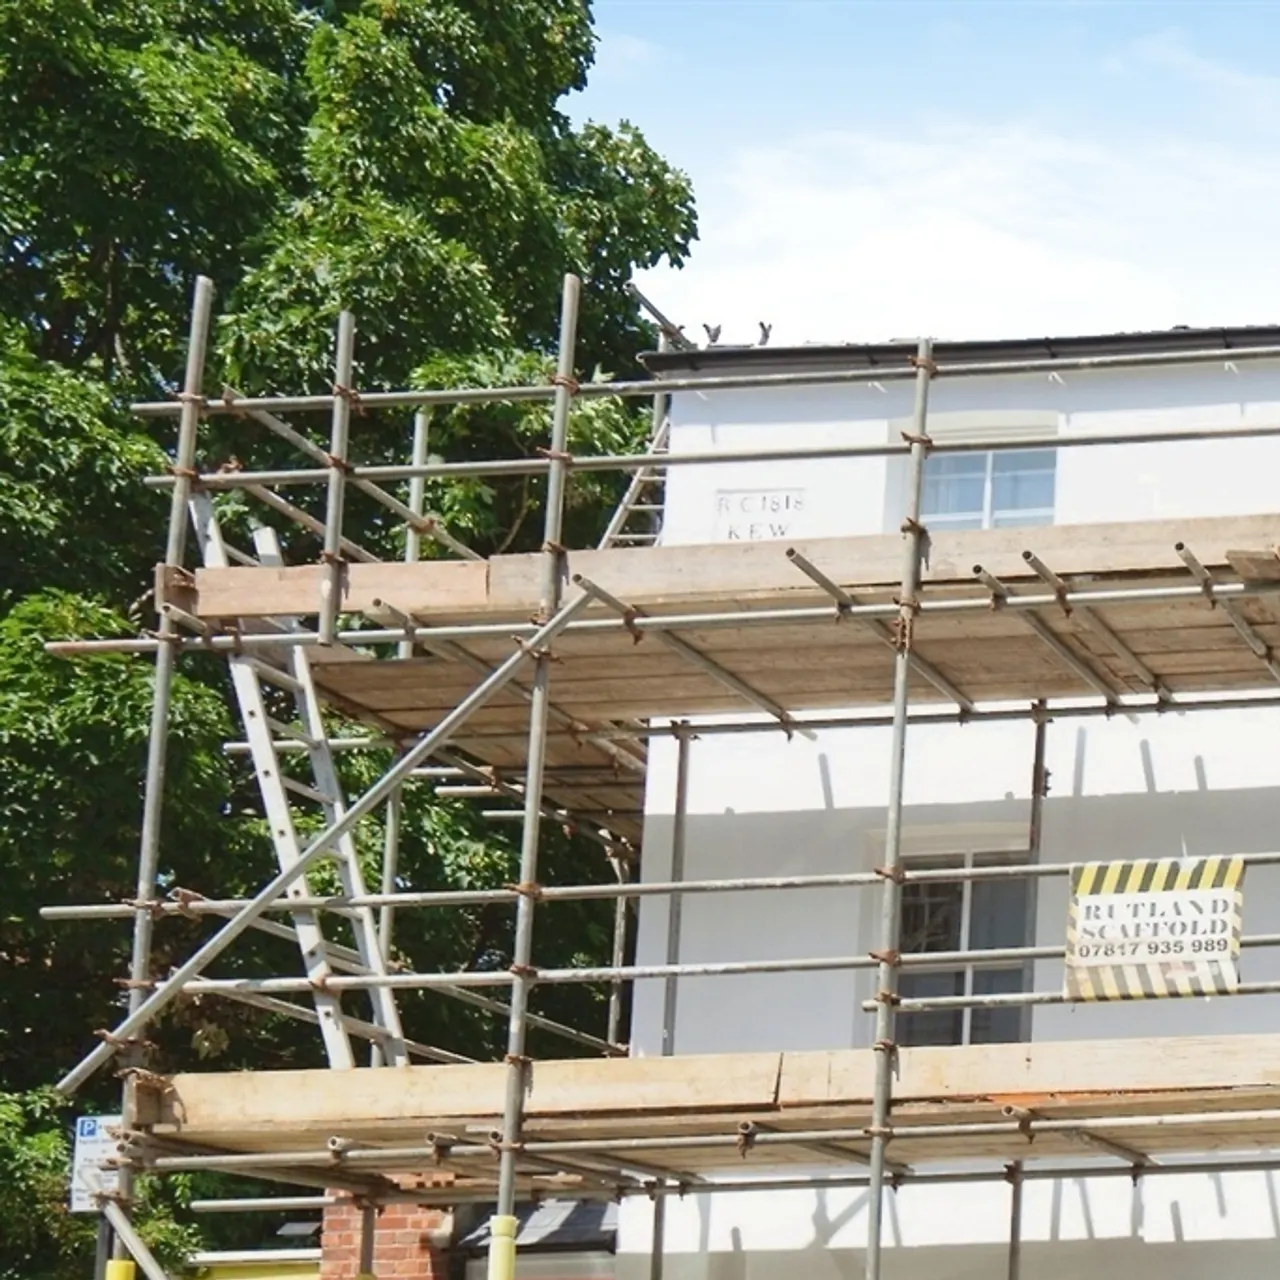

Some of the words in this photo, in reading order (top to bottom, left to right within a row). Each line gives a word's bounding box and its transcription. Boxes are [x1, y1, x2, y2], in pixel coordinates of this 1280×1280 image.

[728, 523, 790, 540] KEW
[1085, 899, 1230, 921] RUTLAND
[1081, 919, 1229, 940] SCAFFOLD
[1147, 940, 1185, 955] 935
[1191, 938, 1228, 953] 989
